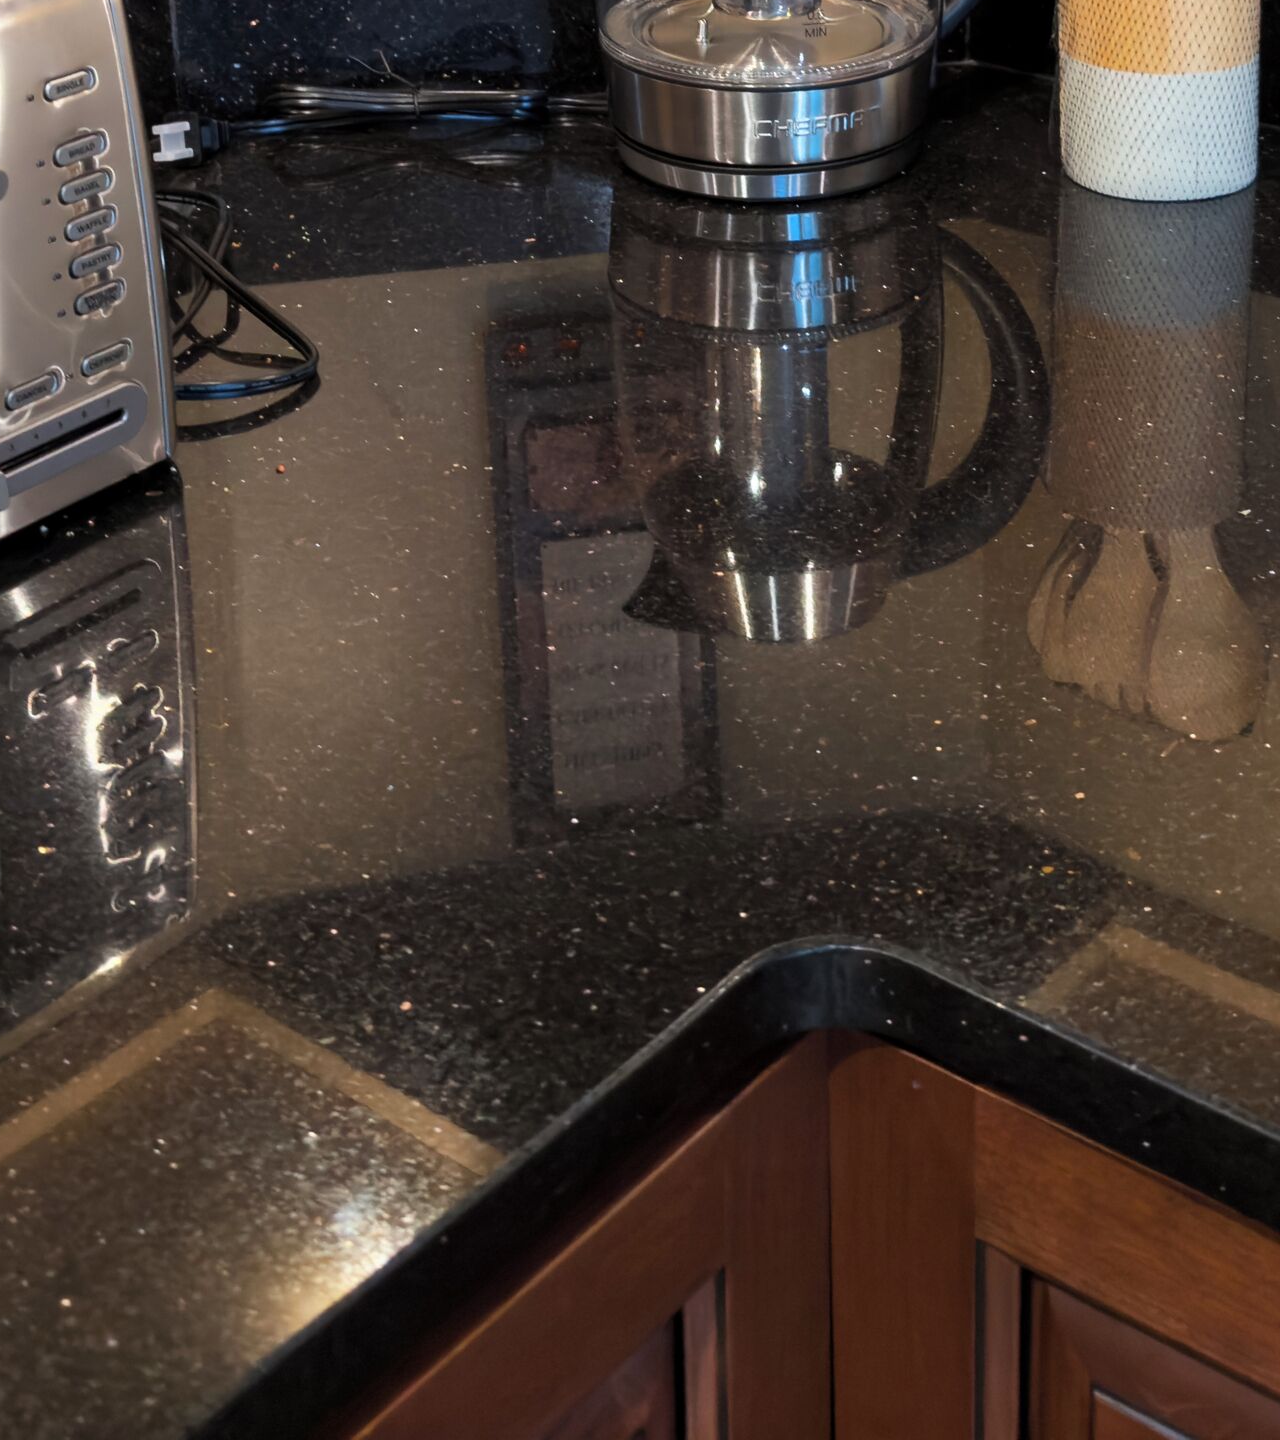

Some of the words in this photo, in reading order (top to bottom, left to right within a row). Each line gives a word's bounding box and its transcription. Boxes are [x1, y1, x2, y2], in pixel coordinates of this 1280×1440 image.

[805, 26, 827, 38] MIN
[68, 142, 96, 158] BREAD
[76, 215, 107, 233] WAFFLE
[81, 253, 111, 270] PASTRY
